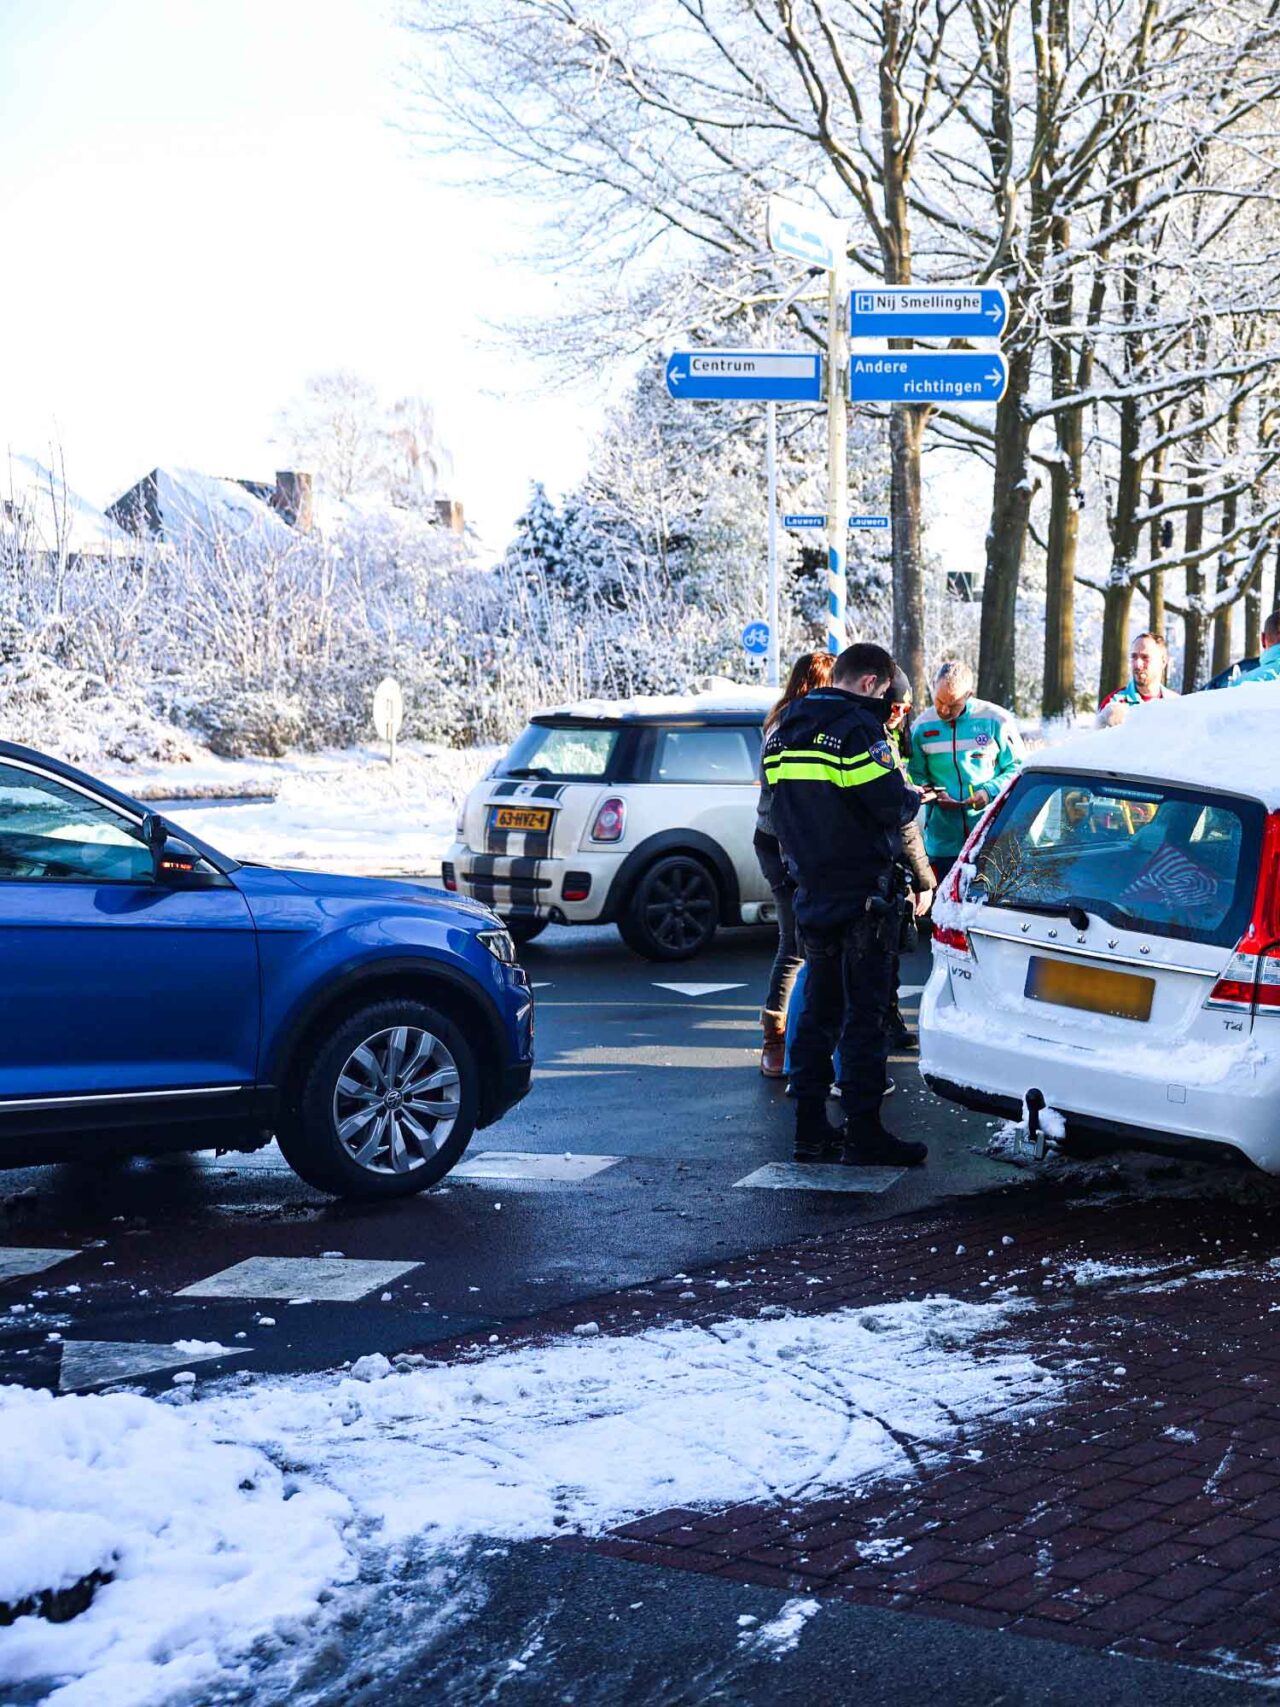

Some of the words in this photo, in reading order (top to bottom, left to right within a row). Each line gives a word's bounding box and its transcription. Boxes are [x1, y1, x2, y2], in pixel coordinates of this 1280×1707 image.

[876, 296, 896, 311] Nij
[901, 296, 980, 310] Smellinghe
[692, 358, 756, 371] Centrum
[855, 360, 908, 373] Andere
[904, 379, 982, 396] richtingen
[1021, 922, 1151, 955] VOLVO
[951, 968, 972, 981] V70
